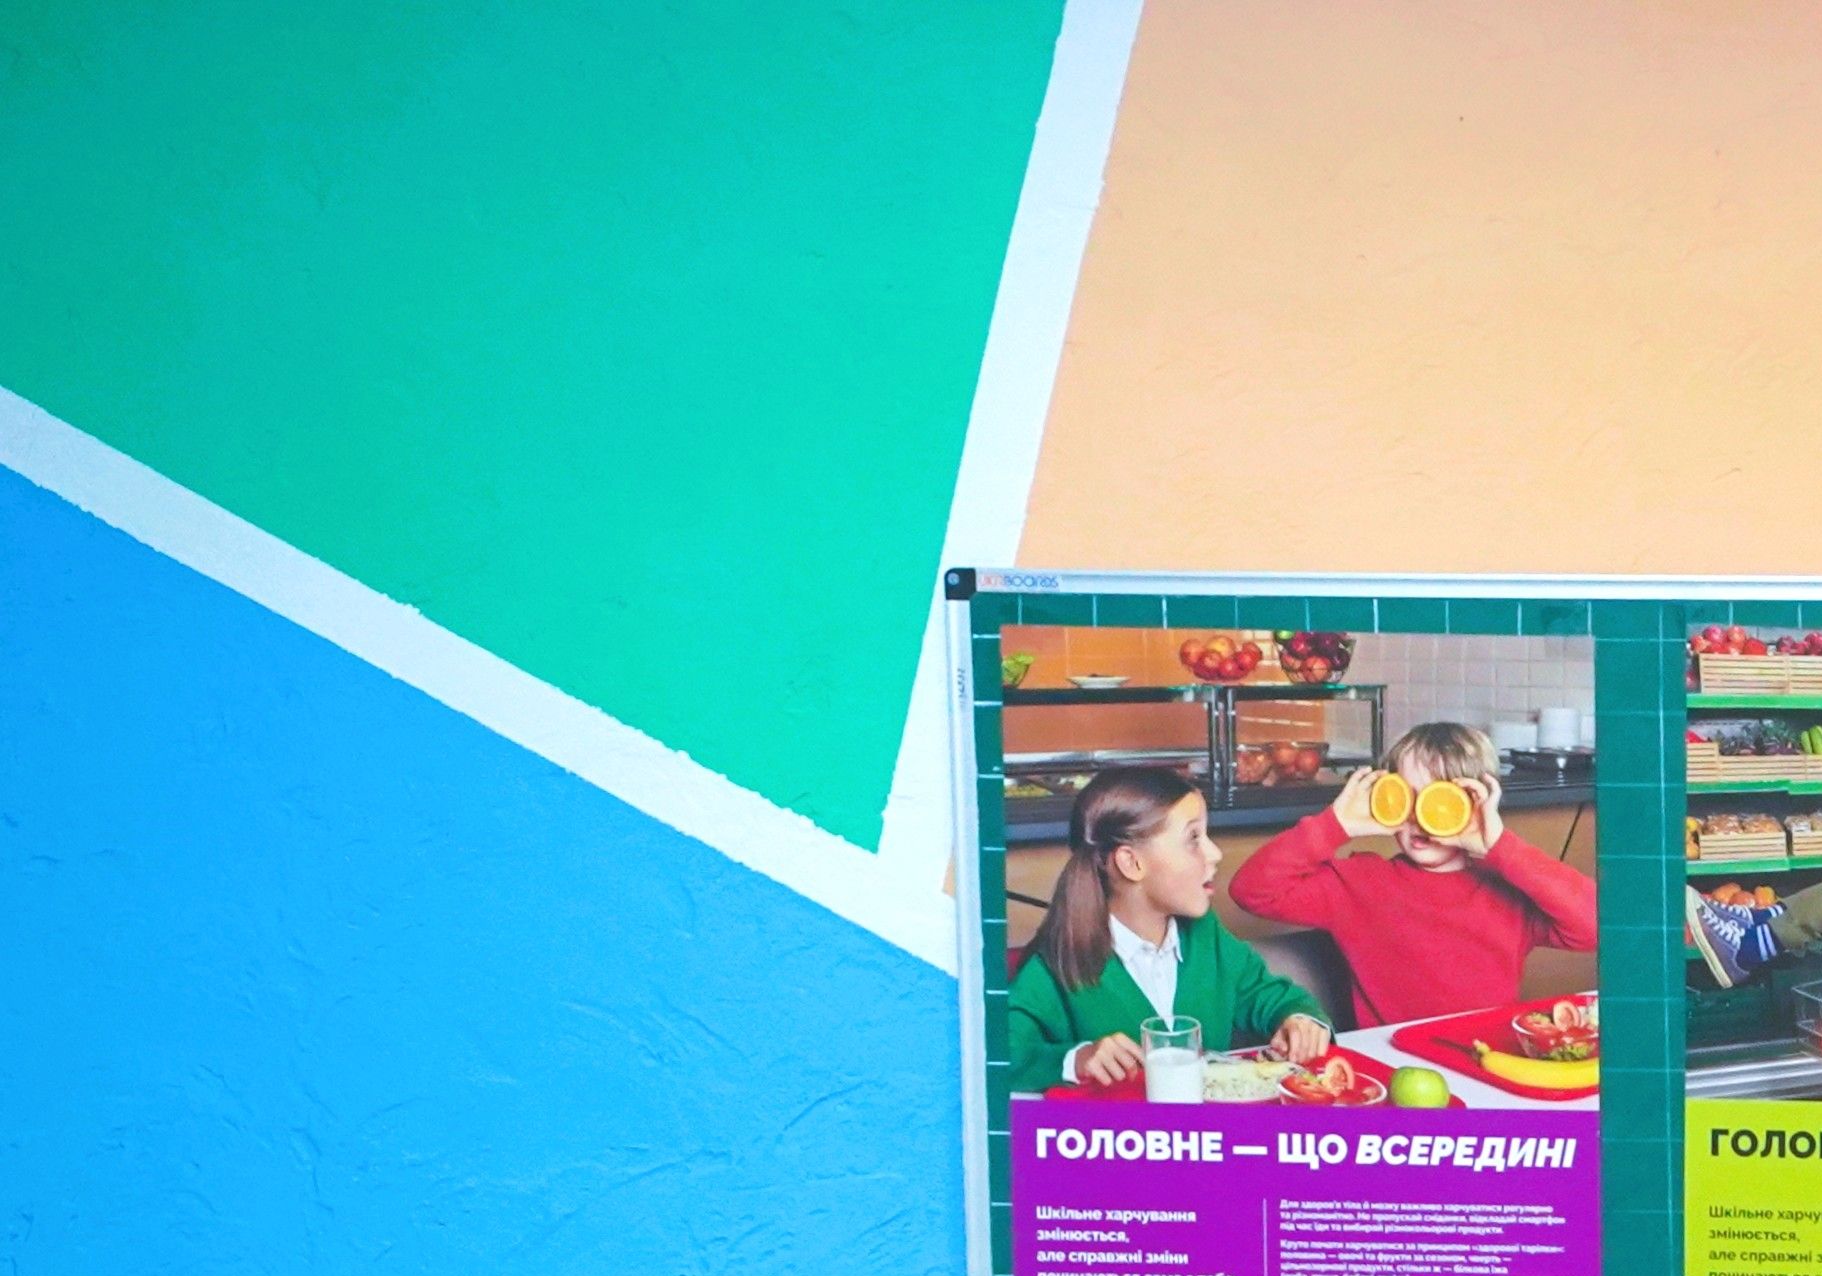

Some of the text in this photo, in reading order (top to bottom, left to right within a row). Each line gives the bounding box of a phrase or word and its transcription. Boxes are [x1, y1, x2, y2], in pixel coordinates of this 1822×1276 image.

[1036, 1128, 1576, 1172] ГОЛОВНЕ — ЩО ВСЕРЕДИНІ
[1036, 1206, 1196, 1224] Шкільне харчування
[1709, 1205, 1772, 1219] Шкільне
[1036, 1226, 1128, 1243] змінюється,
[1709, 1226, 1799, 1243] змінюється,
[1037, 1248, 1188, 1265] але справжні зміни
[1709, 1251, 1735, 1261] але
[1740, 1248, 1812, 1265] справжні
